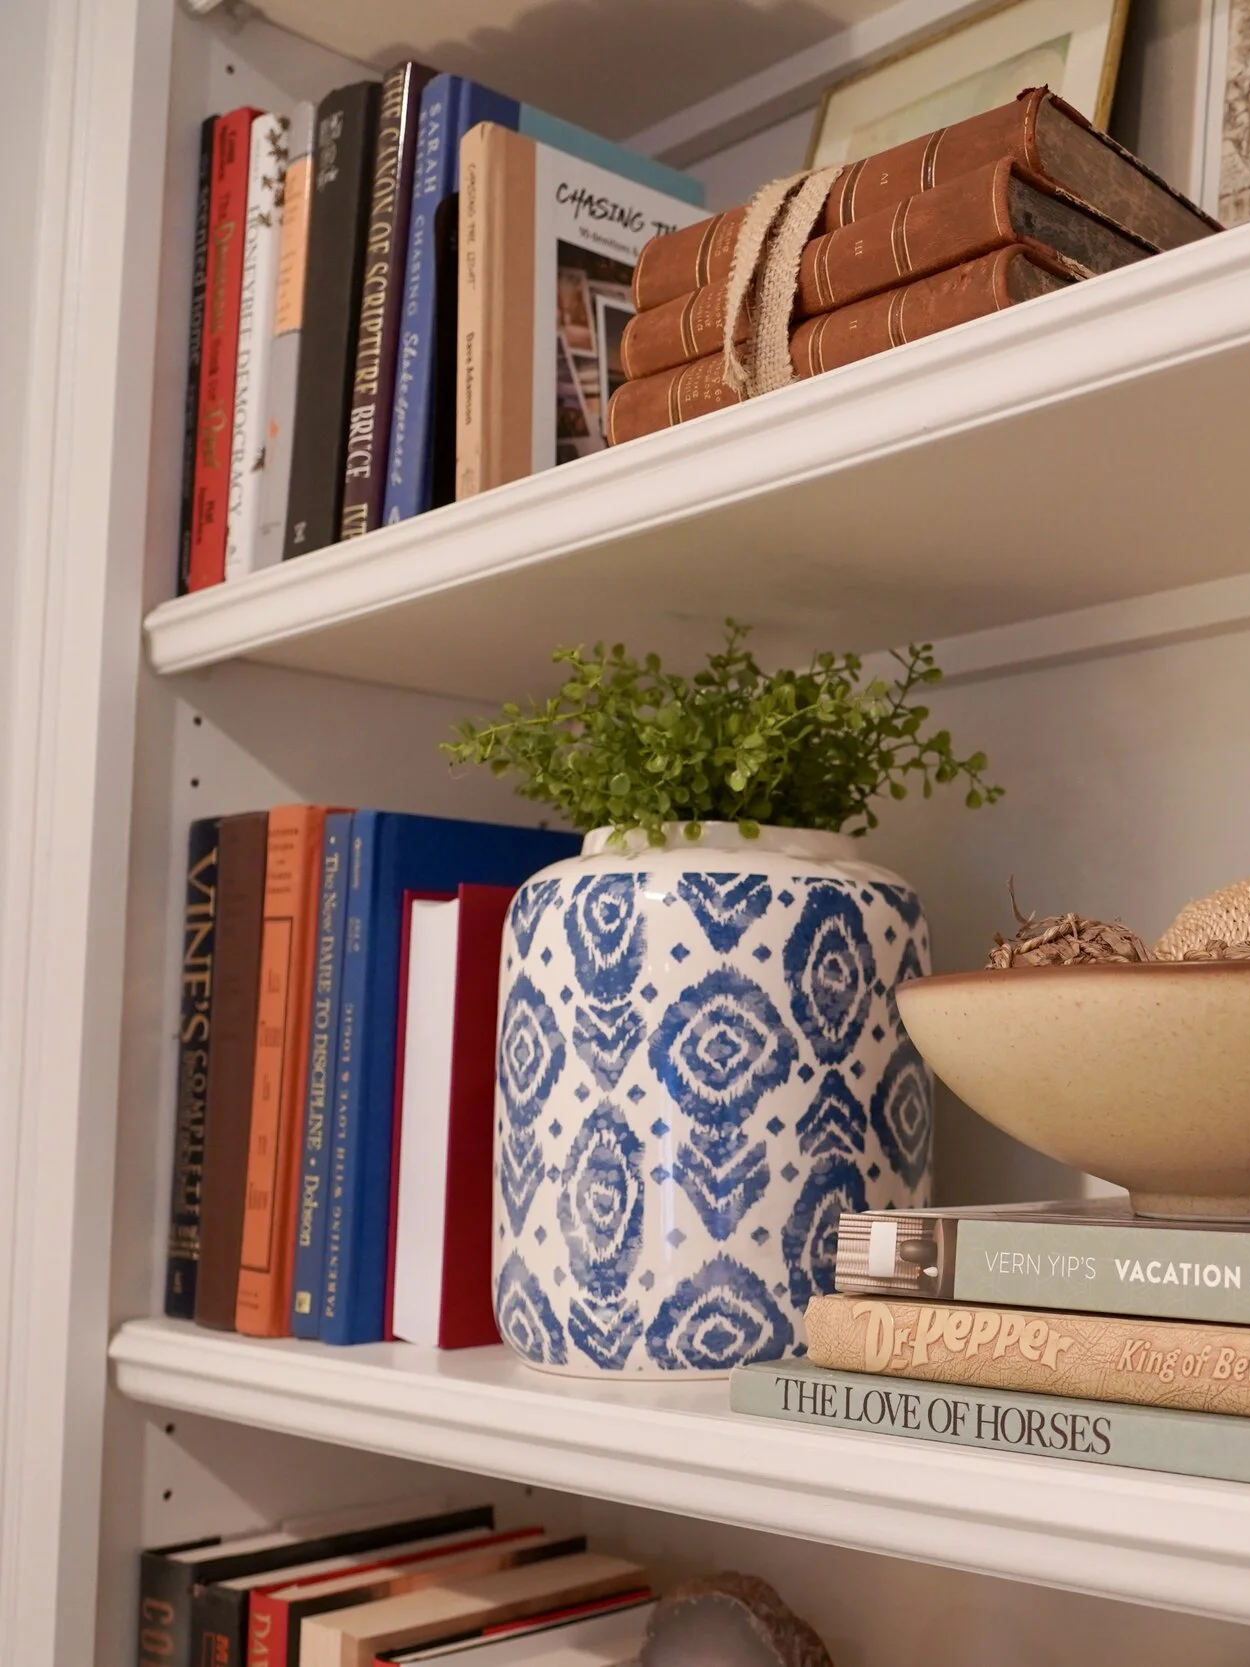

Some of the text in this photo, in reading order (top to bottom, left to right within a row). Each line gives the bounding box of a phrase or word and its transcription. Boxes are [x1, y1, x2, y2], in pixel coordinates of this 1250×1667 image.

[380, 70, 404, 118] THE
[372, 126, 400, 214] CANON
[423, 101, 443, 194] SARAH
[367, 221, 392, 254] OF
[555, 182, 646, 233] CHASING
[237, 204, 260, 343] HONEYBEE
[406, 213, 426, 317] CHASING
[353, 262, 389, 396] SCRIPTURE
[228, 349, 251, 517] DEMOCRACY
[345, 403, 376, 484] BRUCE
[181, 847, 218, 1042] VINE'S
[299, 852, 339, 1247] The New DARE TO DISCIPLINE Dobson
[341, 1003, 355, 1063] LOGIC
[337, 1090, 349, 1139] LOVE
[333, 1146, 346, 1199] WITH
[324, 1206, 342, 1318] PARENTING
[984, 1251, 1041, 1276] VERN
[1048, 1254, 1097, 1280] YIP'S
[1114, 1258, 1242, 1290] VACATION
[909, 1307, 1076, 1372] Pepper
[1116, 1338, 1181, 1383] King
[1182, 1344, 1213, 1377] of
[775, 1376, 1112, 1456] THE LOVE OF HORSES
